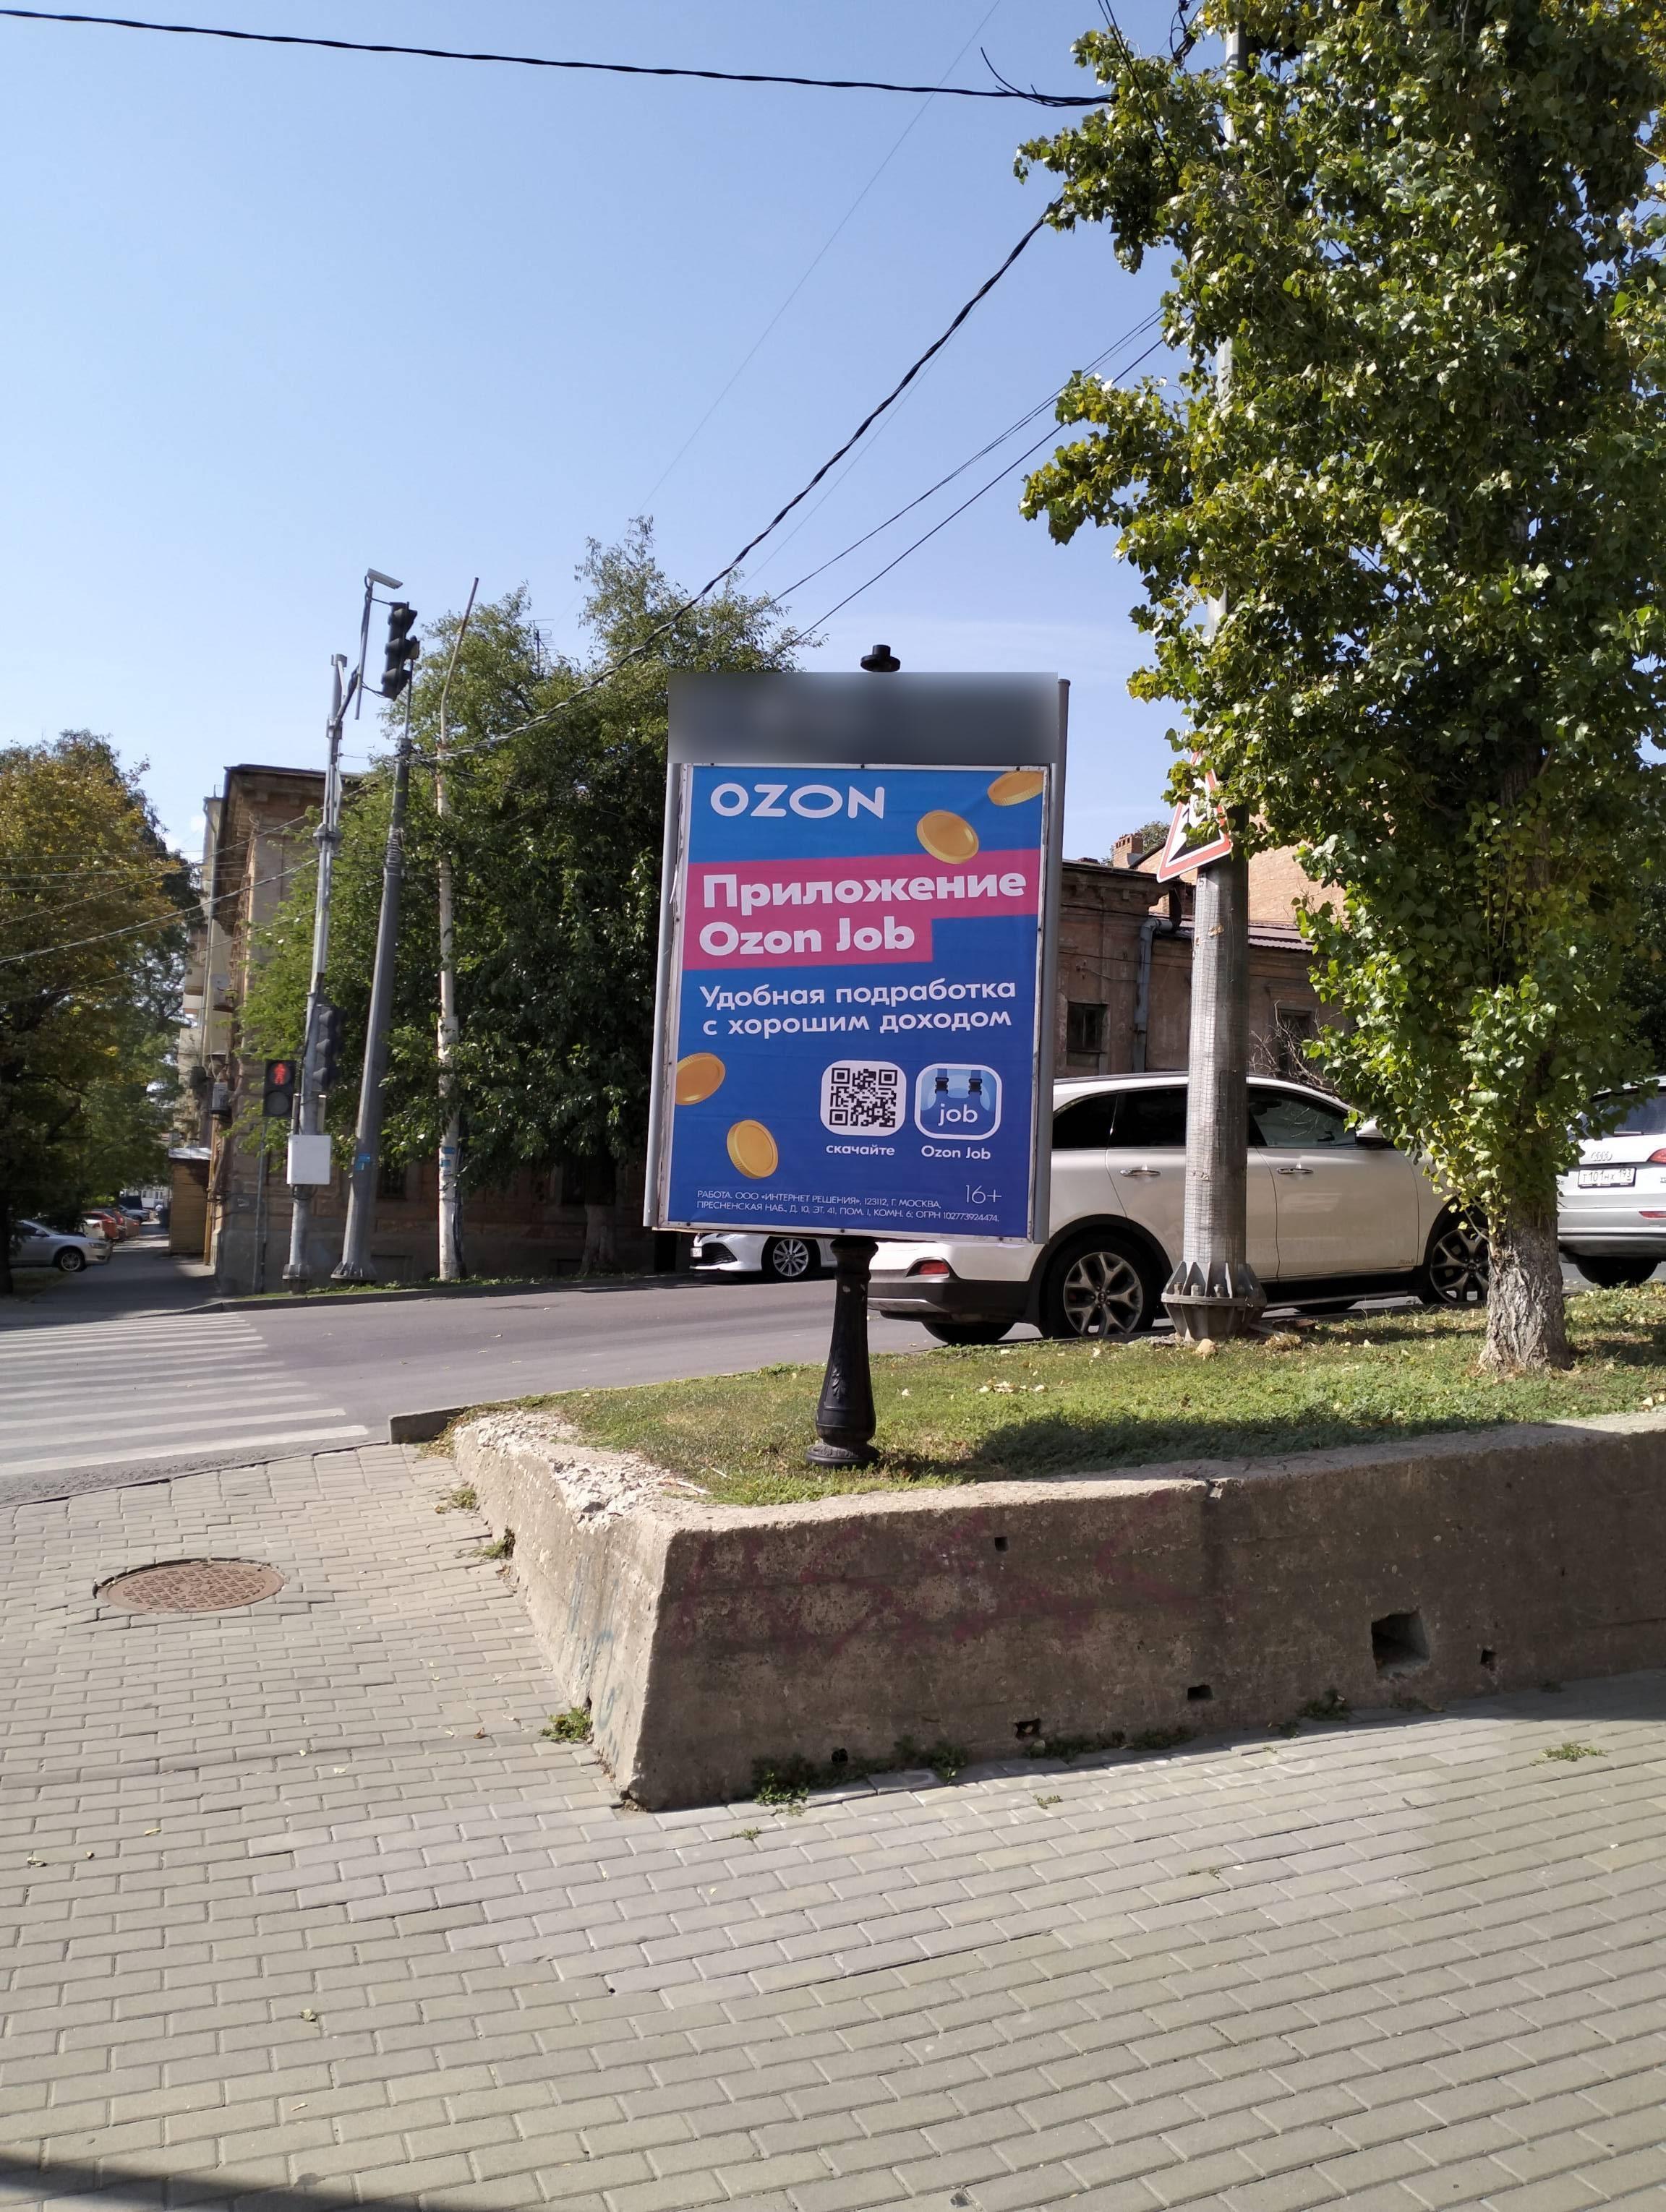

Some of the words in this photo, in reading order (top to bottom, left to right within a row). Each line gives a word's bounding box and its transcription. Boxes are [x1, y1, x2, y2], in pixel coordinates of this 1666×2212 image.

[711, 783, 885, 819] OZON
[703, 872, 1027, 916] Приложение
[699, 922, 822, 956] Ozon
[836, 915, 915, 952] Job
[699, 982, 825, 1011] Удобная
[836, 977, 1016, 1008] подработка
[703, 1020, 717, 1036] с
[728, 1015, 870, 1039] хорошим
[879, 1009, 1012, 1034] доходом
[938, 1103, 978, 1126] job
[826, 1144, 895, 1156] скачайте
[920, 1145, 961, 1158] Ozon
[965, 1146, 991, 1159] Job
[735, 1191, 759, 1200] ООО
[761, 1193, 810, 1202] «ИНТЕРНЕТ
[898, 1199, 941, 1209] МОСКВА,
[965, 1185, 1002, 1204] 16+
[696, 1201, 763, 1211] ПРЕСНЕНСКАЯ
[915, 1210, 941, 1219] ОГРН
